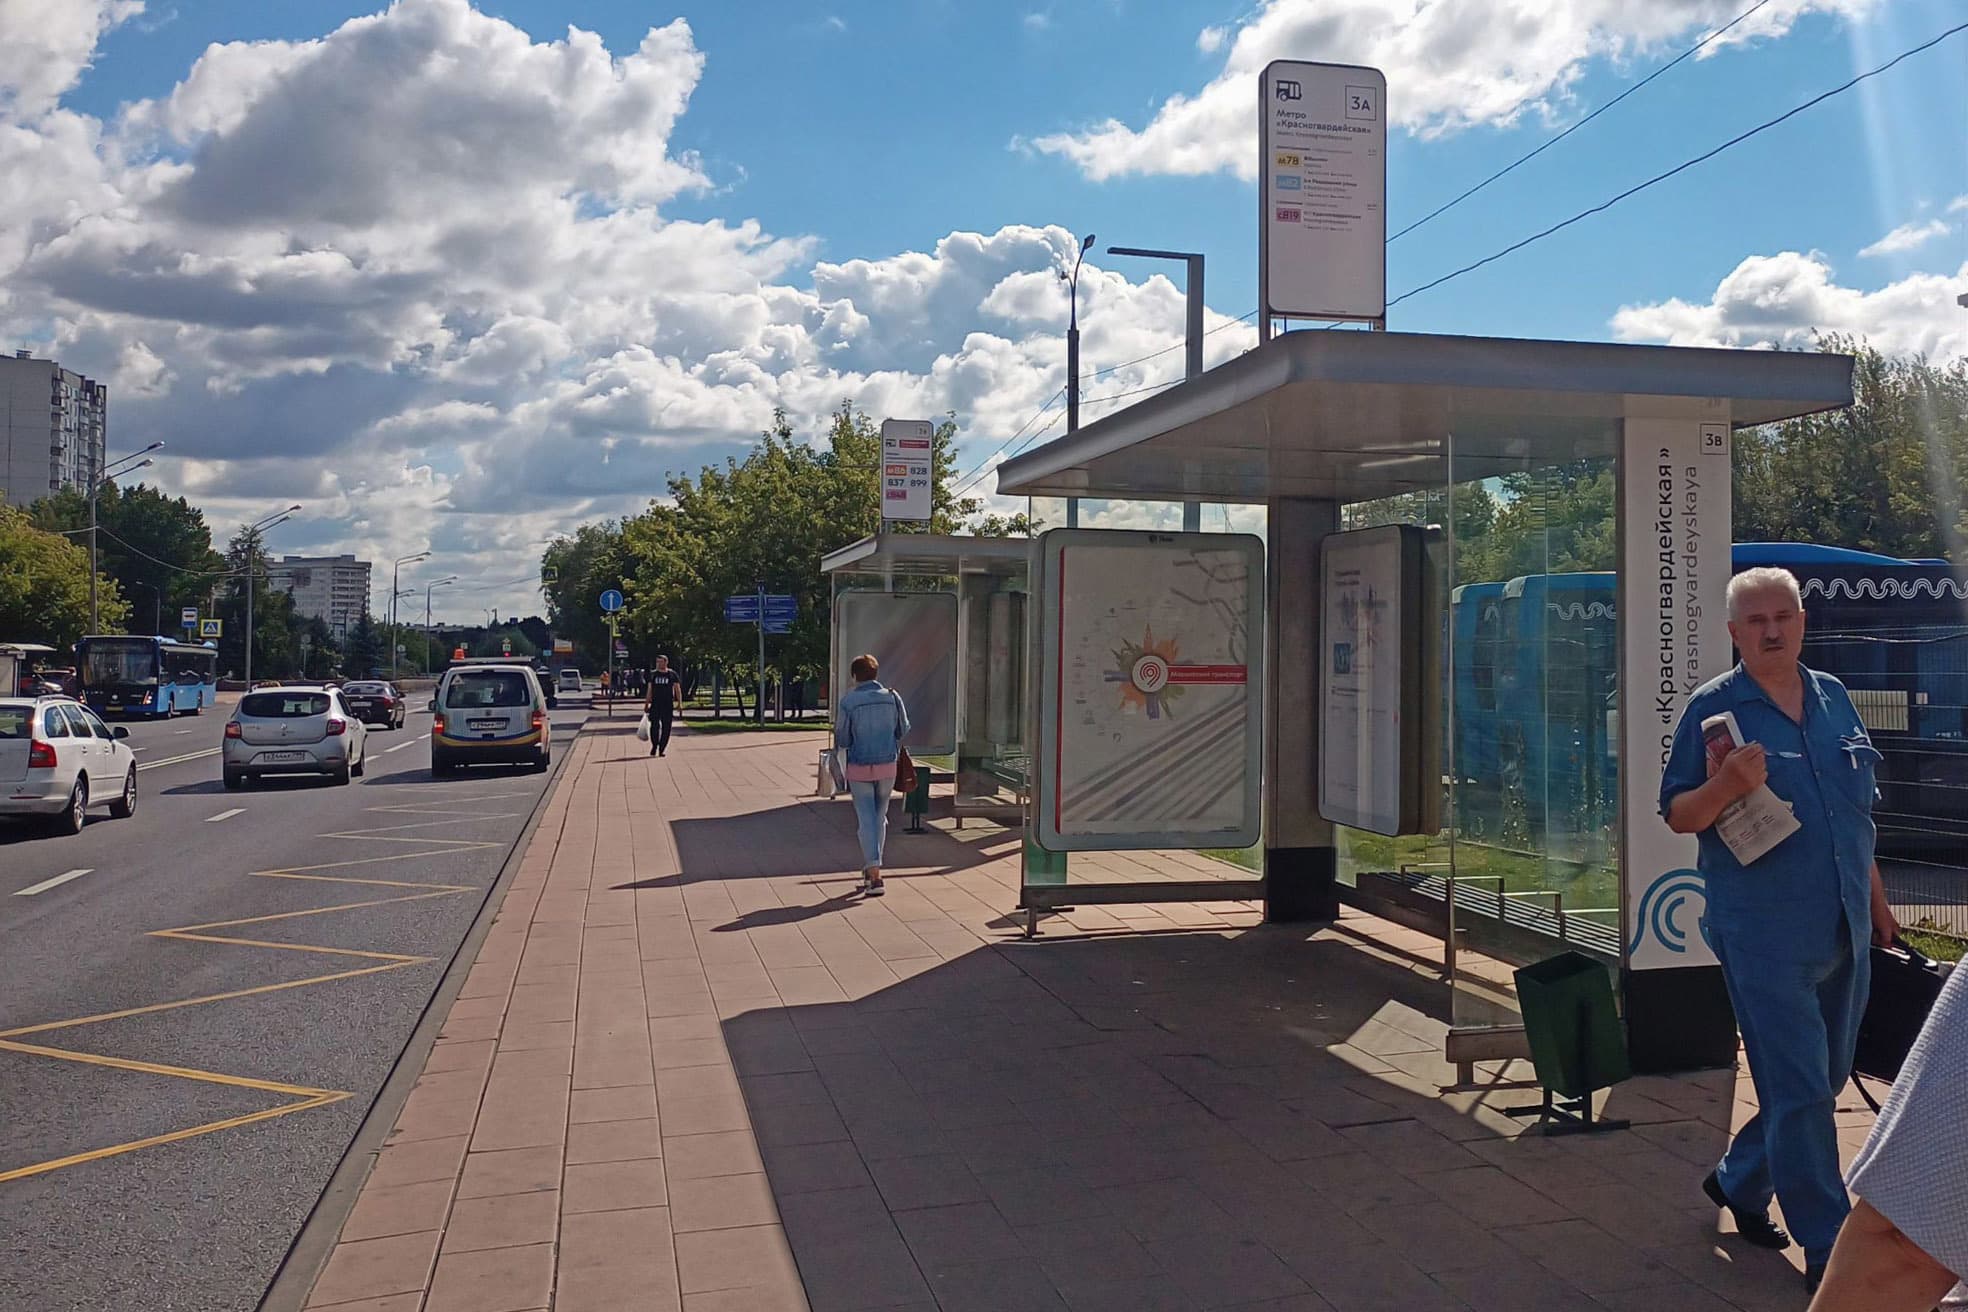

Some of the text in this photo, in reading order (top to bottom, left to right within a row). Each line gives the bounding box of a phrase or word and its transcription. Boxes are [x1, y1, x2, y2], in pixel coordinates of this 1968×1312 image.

[1351, 95, 1371, 111] 3А
[1276, 109, 1307, 119] Метро
[1276, 119, 1372, 134] «Красногвардейская»
[1705, 433, 1723, 447] 3В
[910, 479, 928, 487] 899
[1655, 447, 1678, 724] «Красногвардейская»
[1681, 466, 1702, 696] Krasnogvardeyskaya
